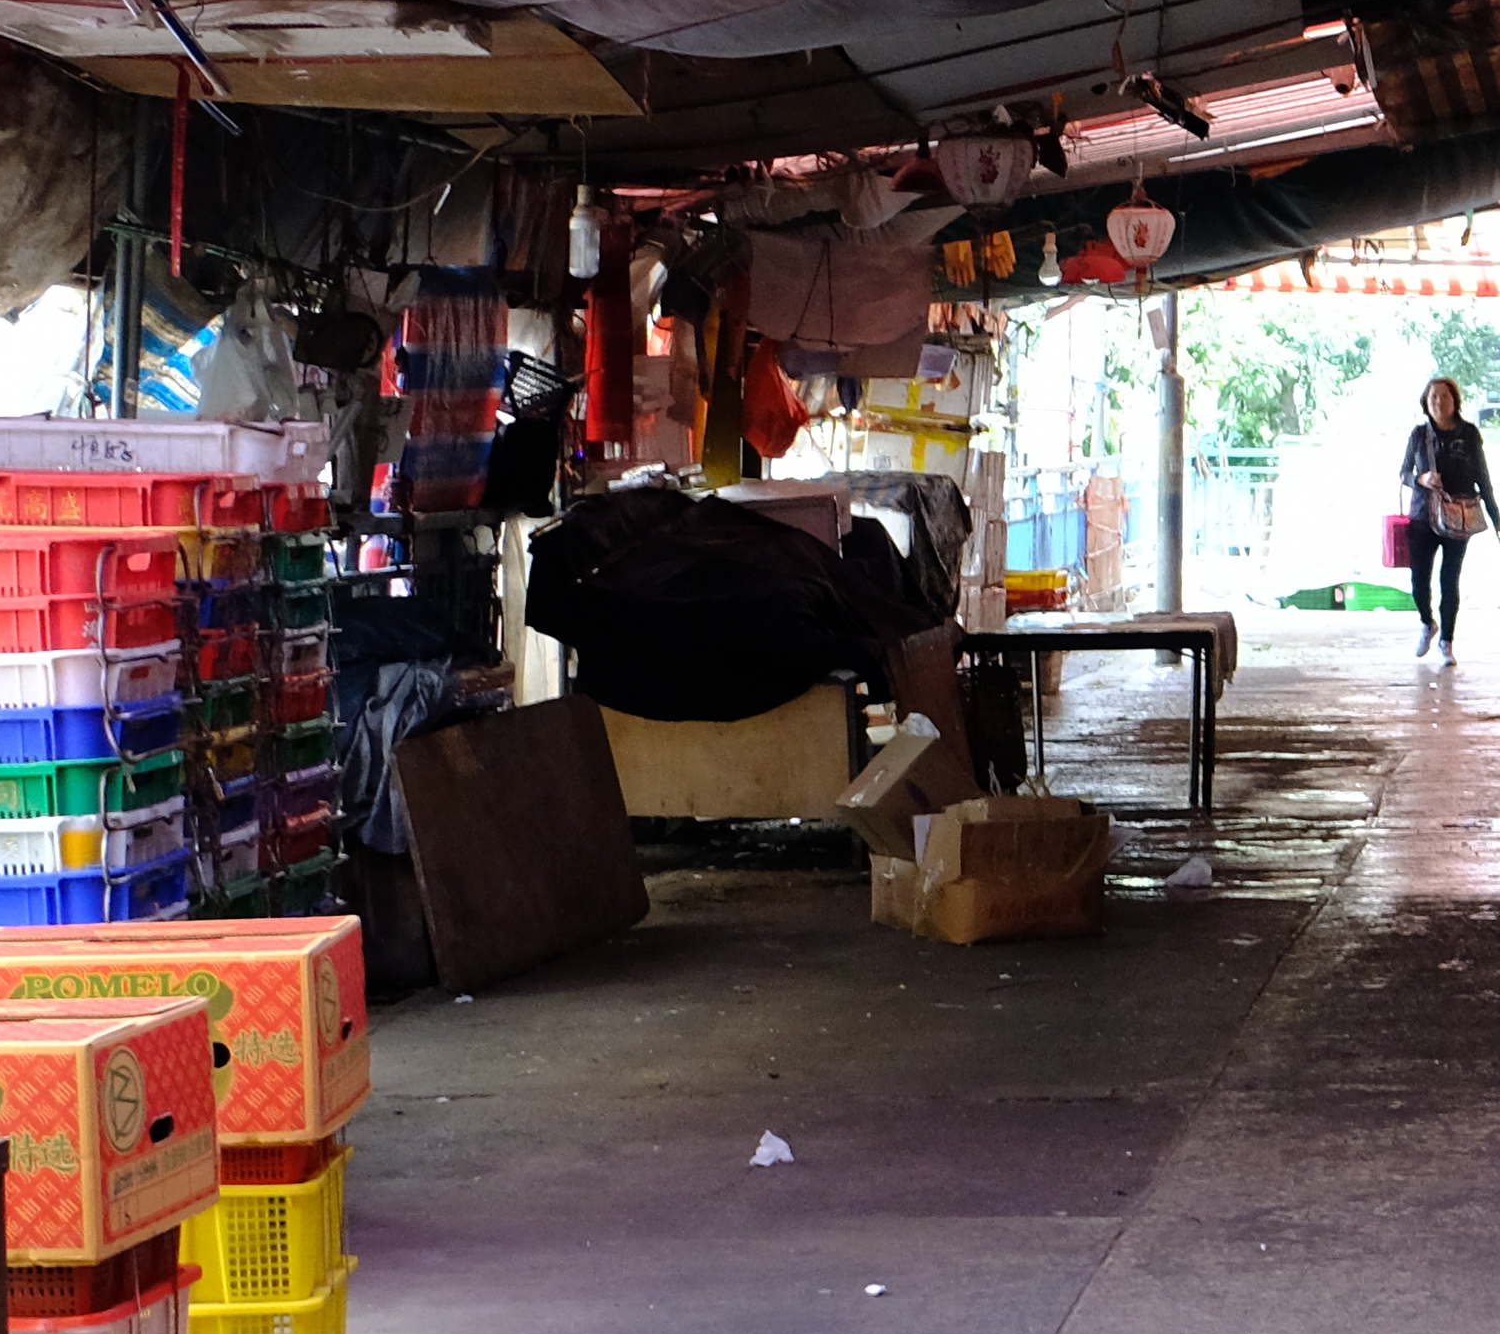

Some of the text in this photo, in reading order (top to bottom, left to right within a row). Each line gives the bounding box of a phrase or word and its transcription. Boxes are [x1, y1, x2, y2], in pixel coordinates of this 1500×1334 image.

[22, 970, 220, 999] POMELO
[233, 1028, 299, 1066] 特选
[9, 1130, 78, 1176] 特选
